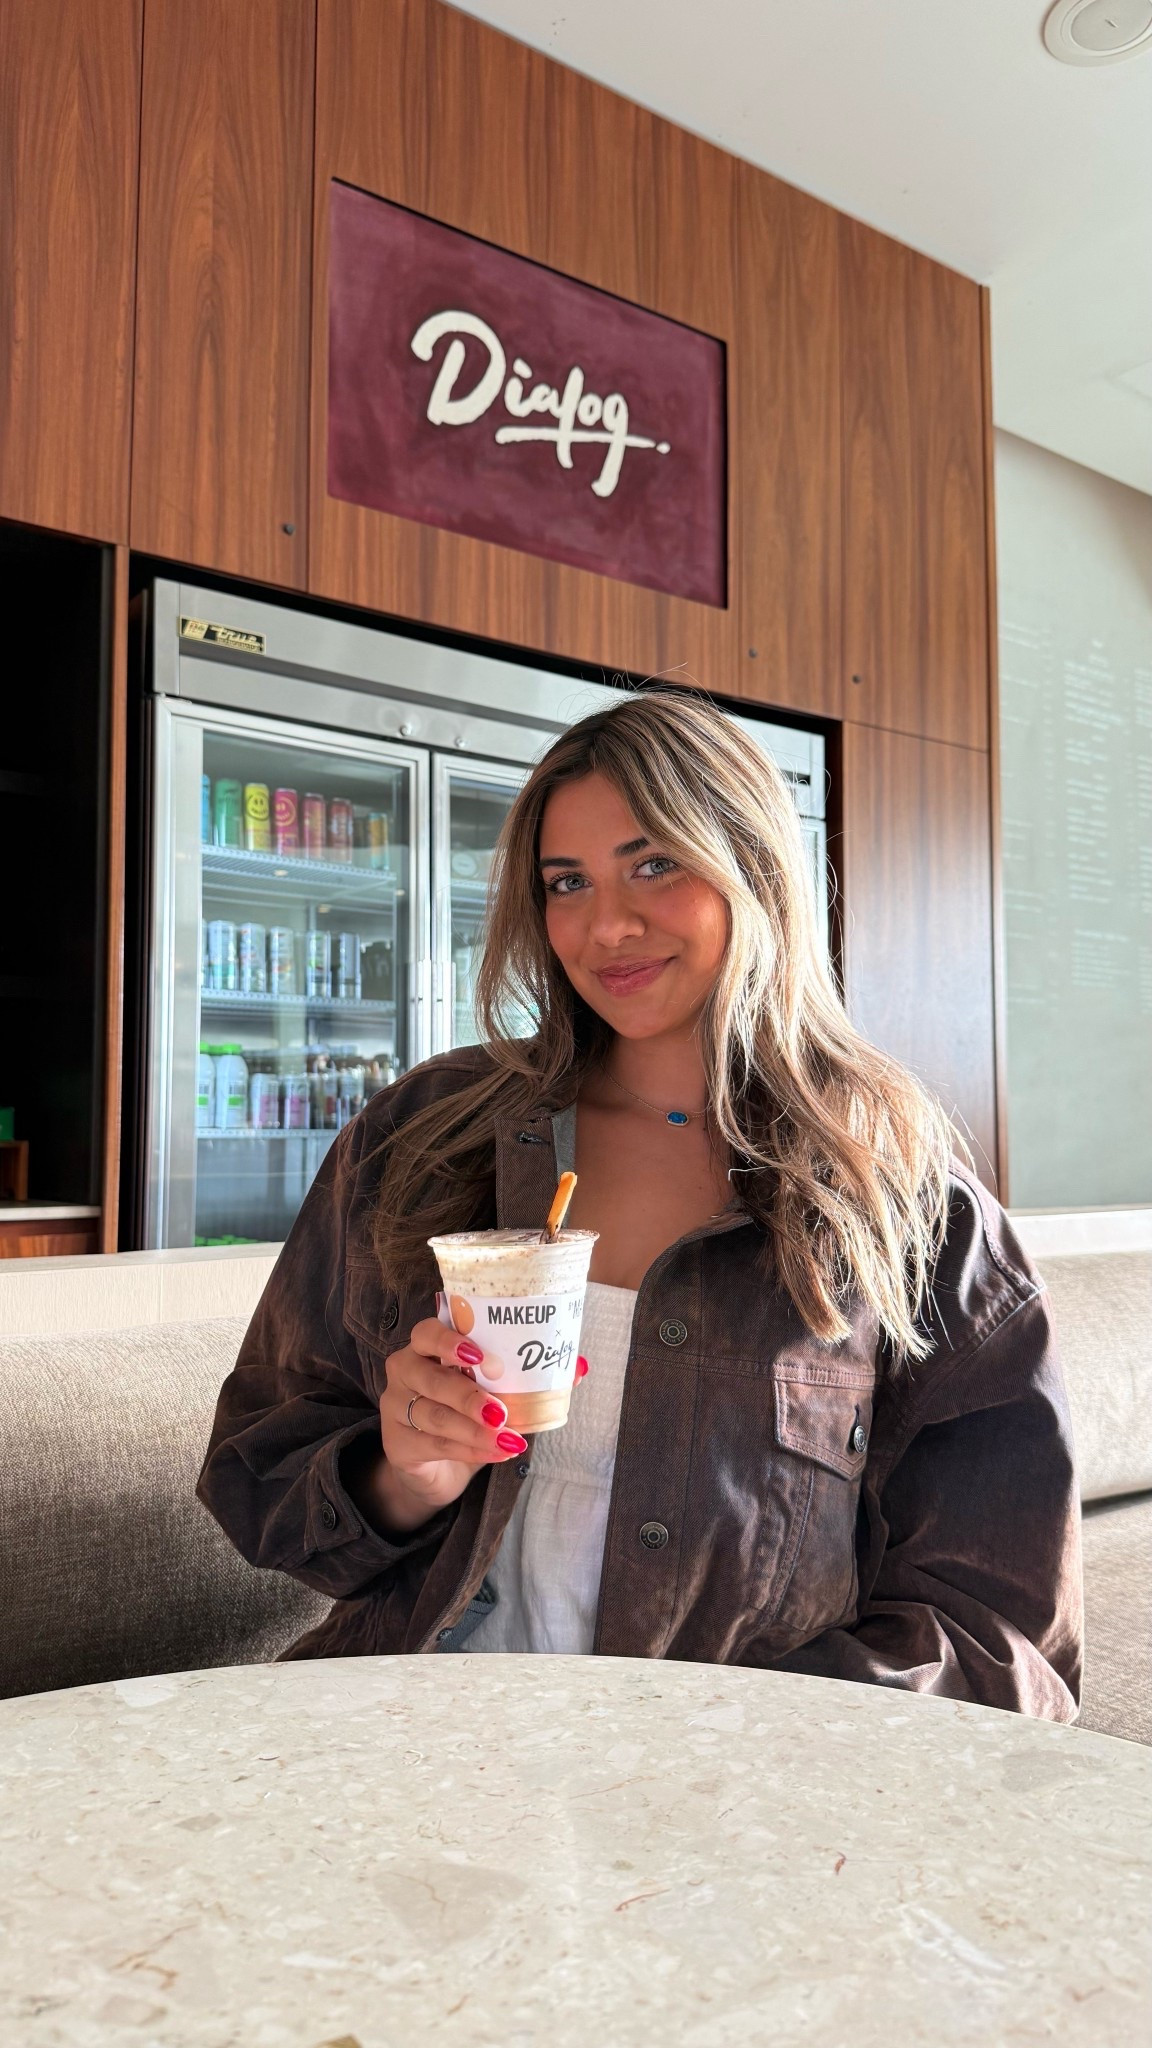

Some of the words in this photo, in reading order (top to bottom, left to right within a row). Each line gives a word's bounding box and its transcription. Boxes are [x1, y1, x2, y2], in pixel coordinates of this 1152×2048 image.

[410, 310, 670, 497] Dialog
[487, 1305, 556, 1325] MAKEUP
[517, 1340, 575, 1372] Dialog
